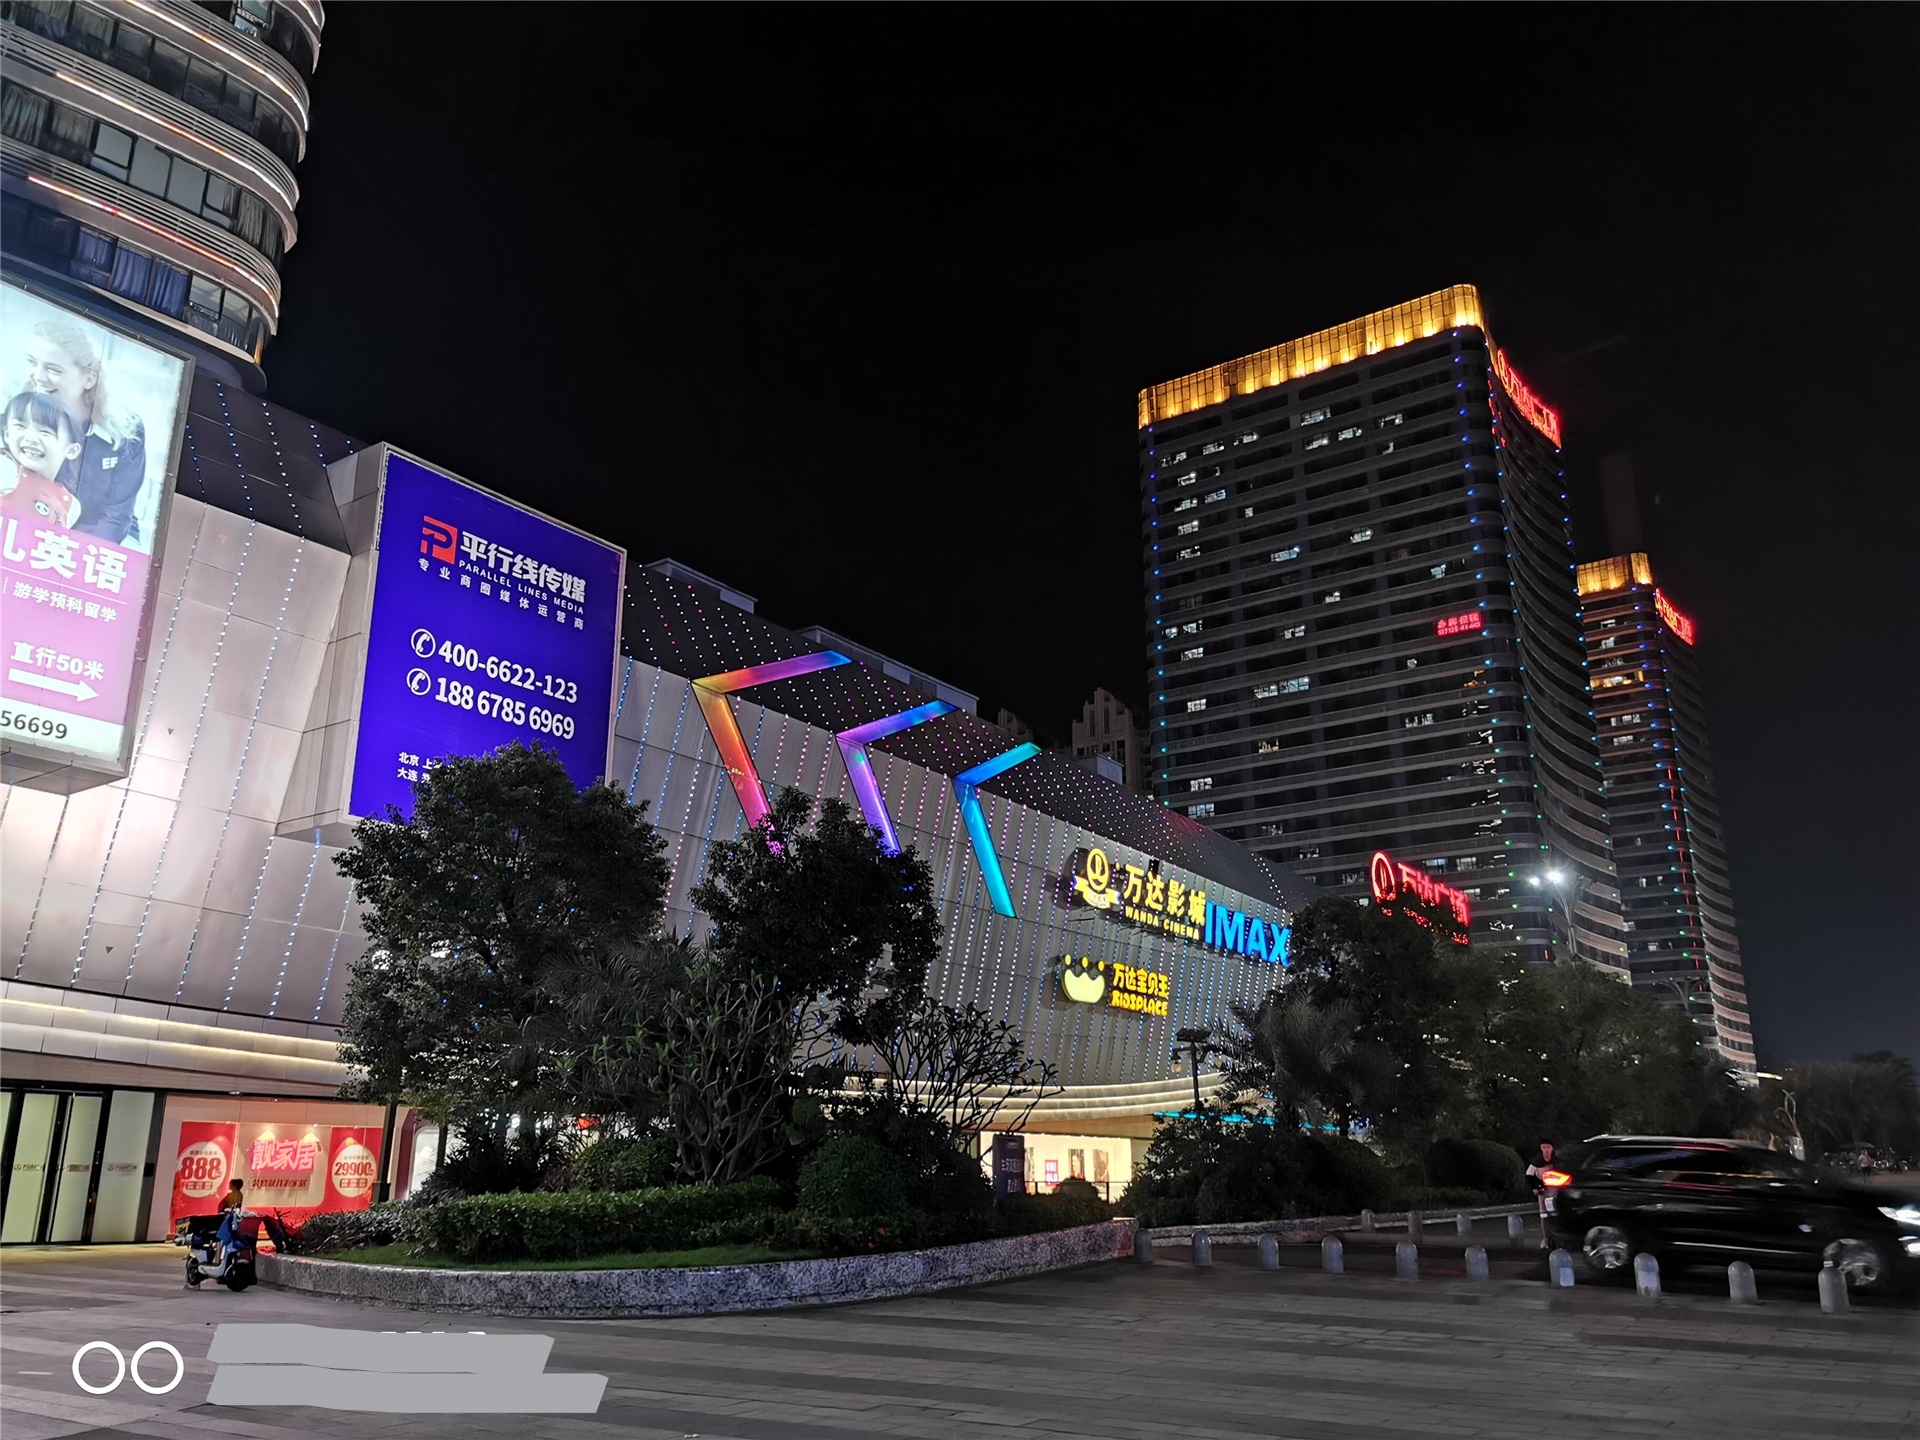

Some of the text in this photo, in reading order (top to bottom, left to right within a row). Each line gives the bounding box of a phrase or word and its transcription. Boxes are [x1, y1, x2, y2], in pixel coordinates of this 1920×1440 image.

[102, 456, 119, 470] EF
[460, 530, 587, 604] 平行线传媒
[13, 581, 117, 622] 游学预科留学
[458, 560, 585, 615] PARALLEL LINES MEDIA
[11, 641, 104, 681] 直行50米
[438, 640, 578, 704] 400-6622-123
[0, 709, 68, 739] 56699
[435, 677, 576, 740] 188 6785 6969
[397, 766, 418, 782] 大连
[398, 751, 420, 767] 北京
[1123, 864, 1207, 927] 万达影城
[1125, 905, 1200, 942] WANDA CINEMA
[1204, 900, 1292, 968] IMAX
[1112, 962, 1169, 999] 万达宝贝王
[251, 1139, 317, 1171] 靓家居
